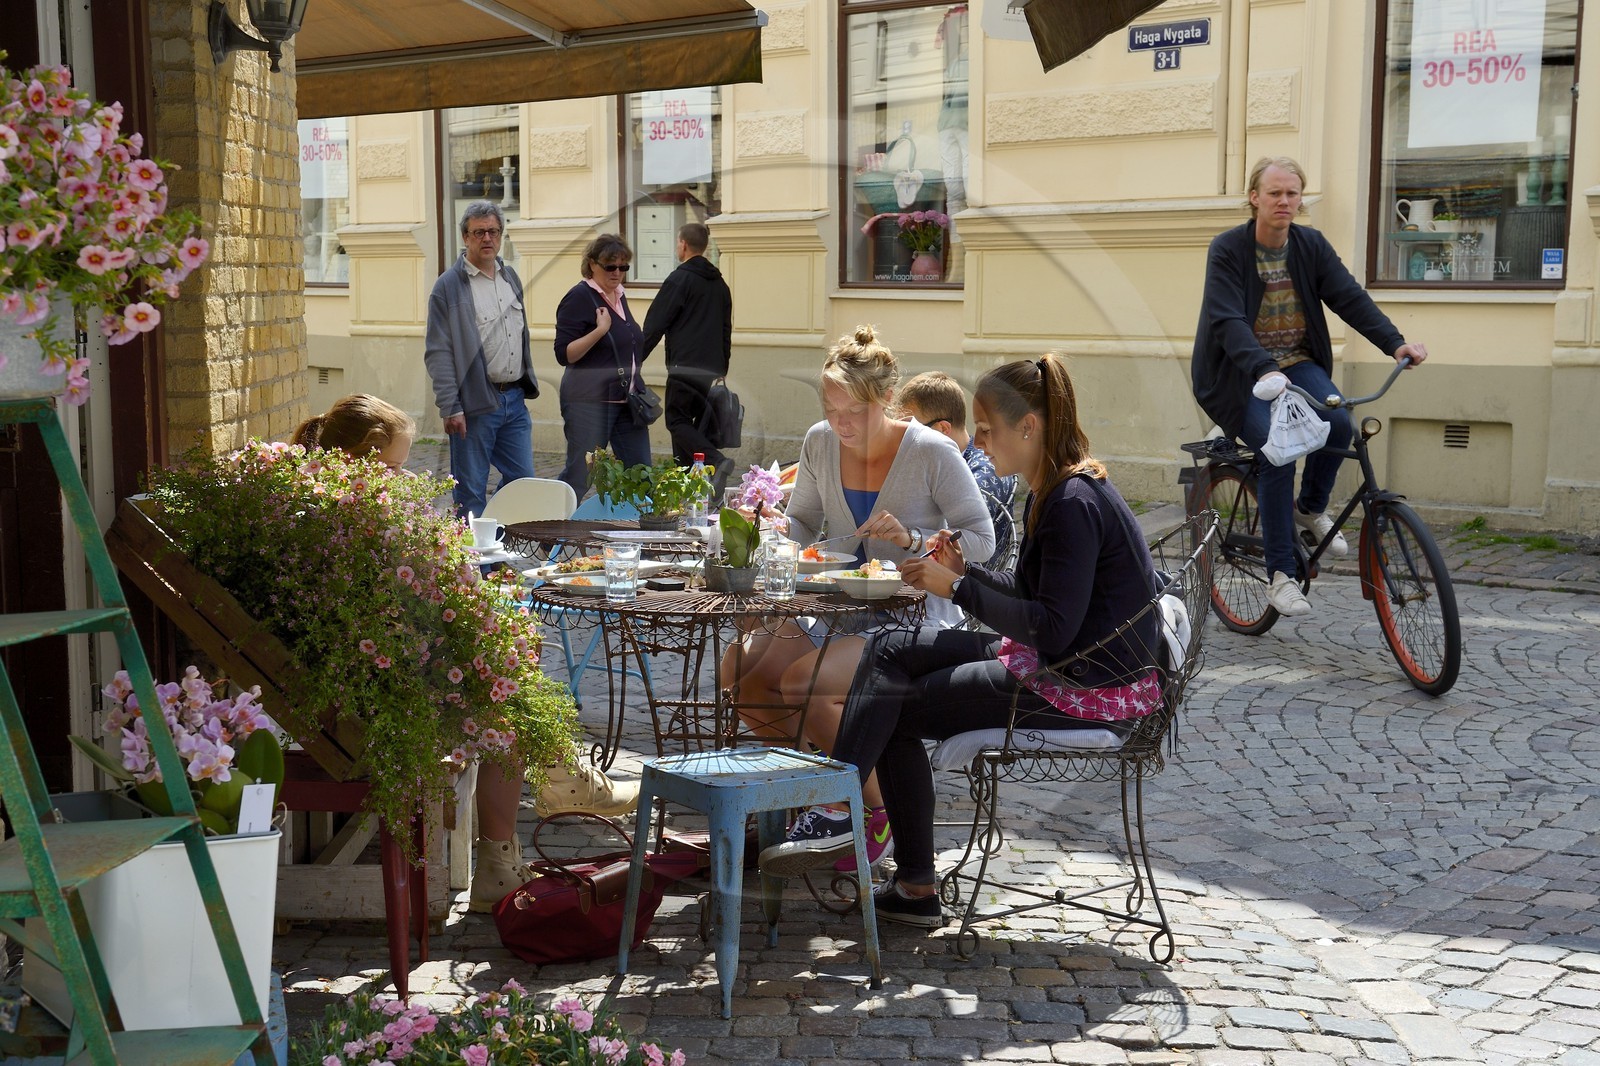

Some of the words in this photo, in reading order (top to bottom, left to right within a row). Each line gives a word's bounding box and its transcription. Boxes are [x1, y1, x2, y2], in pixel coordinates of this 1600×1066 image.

[1135, 31, 1160, 46] Haga
[1163, 25, 1201, 43] Nygata
[1453, 29, 1497, 54] REA
[1157, 51, 1176, 68] 3-1
[1423, 53, 1526, 88] 30-50%
[664, 100, 688, 117] REA
[312, 127, 330, 141] REA
[649, 117, 704, 140] 30-50%
[302, 143, 342, 161] 30-50%
[1424, 261, 1469, 273] HAGA
[1475, 260, 1511, 273] HEM
[875, 271, 939, 282] www.hagahem.com
